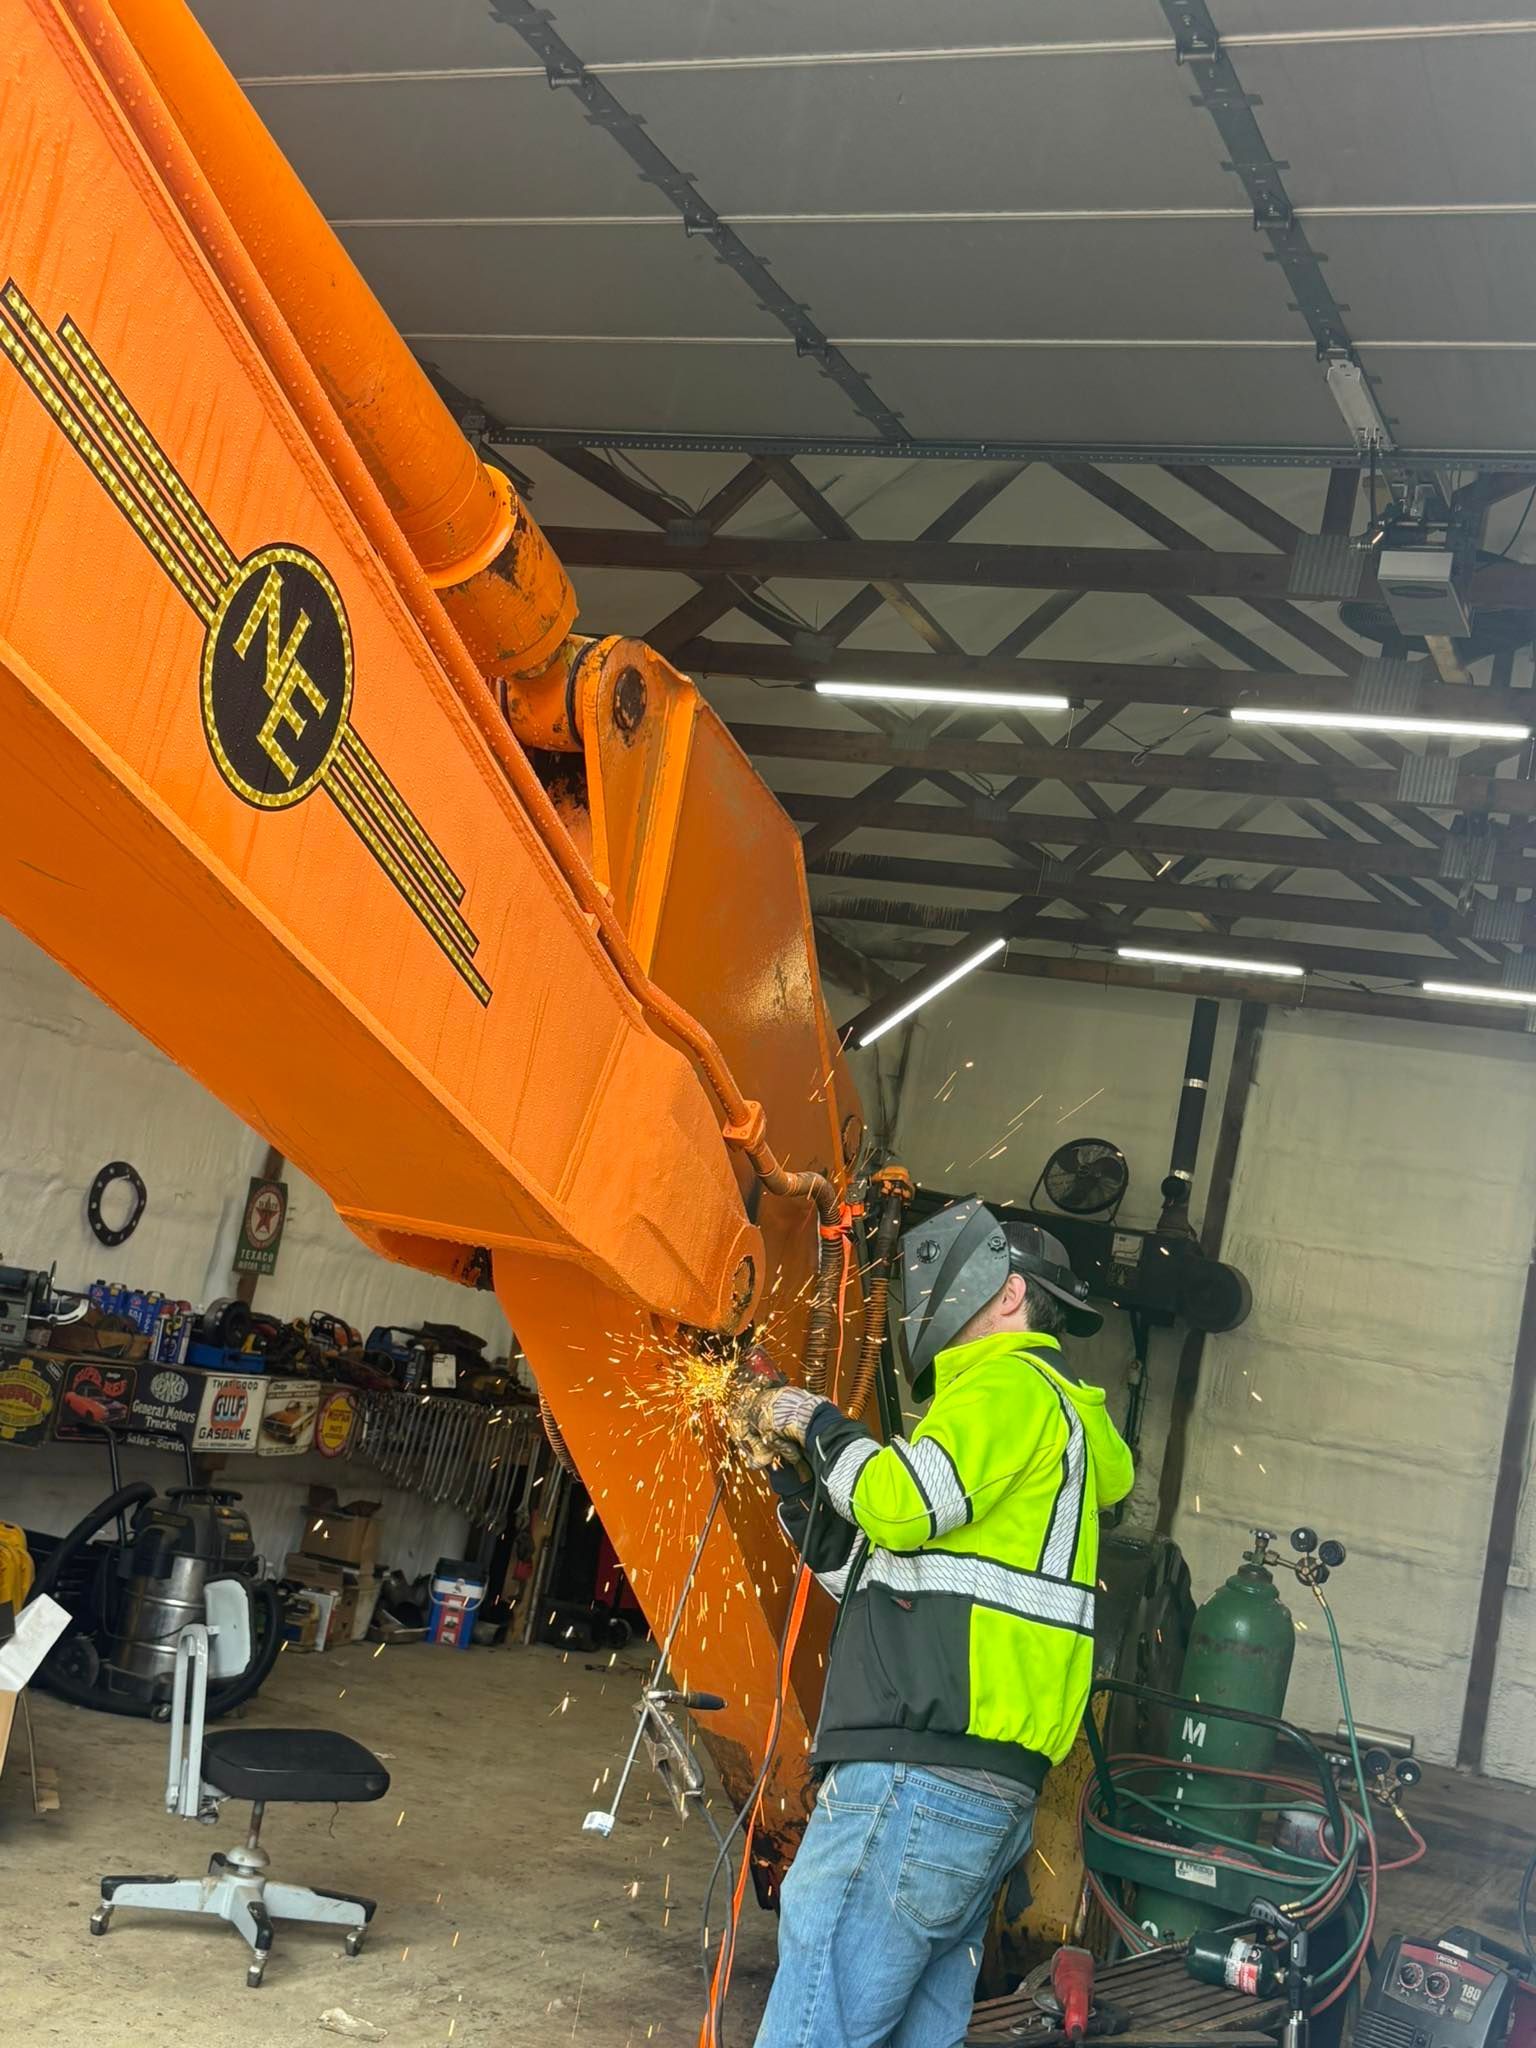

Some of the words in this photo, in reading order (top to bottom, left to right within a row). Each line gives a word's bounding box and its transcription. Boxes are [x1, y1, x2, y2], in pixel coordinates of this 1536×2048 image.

[241, 1248, 274, 1263] TEXACO
[213, 1380, 234, 1388] THAT
[236, 1381, 258, 1390] GOOD
[132, 1400, 165, 1418] General
[166, 1406, 196, 1424] Motors
[215, 1395, 246, 1420] GULF
[145, 1416, 177, 1431] Trucks
[199, 1427, 251, 1440] GASOLINE
[1461, 1984, 1482, 2001] 180
